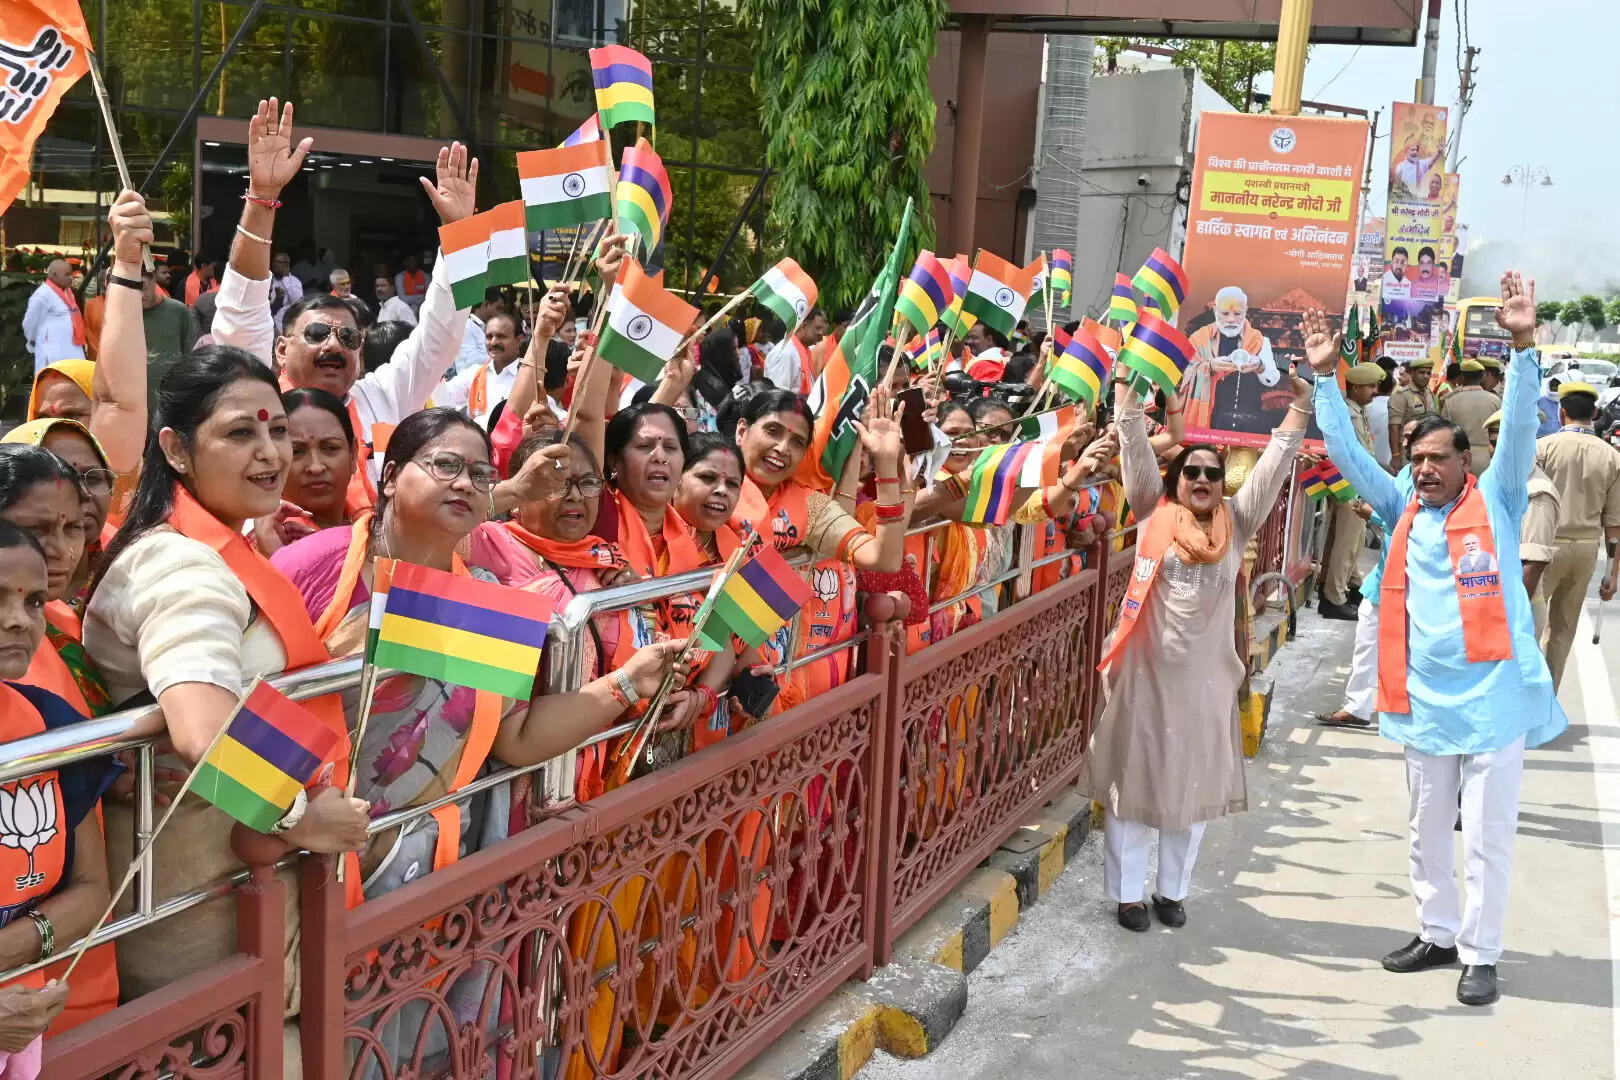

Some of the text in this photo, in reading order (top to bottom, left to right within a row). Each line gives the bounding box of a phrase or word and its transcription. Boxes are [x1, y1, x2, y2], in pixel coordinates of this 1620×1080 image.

[1208, 156, 1352, 176] विश्व की प्राचीनतम नगरी काशी में
[1244, 179, 1310, 192] यशस्वी प्रधानमंत्री
[1210, 190, 1341, 212] माननीय नरेन्द्र मोदी जी
[1195, 216, 1349, 245] हार्दिक स्वागत एवं अभिनंदन
[1458, 575, 1499, 588] भाजपा
